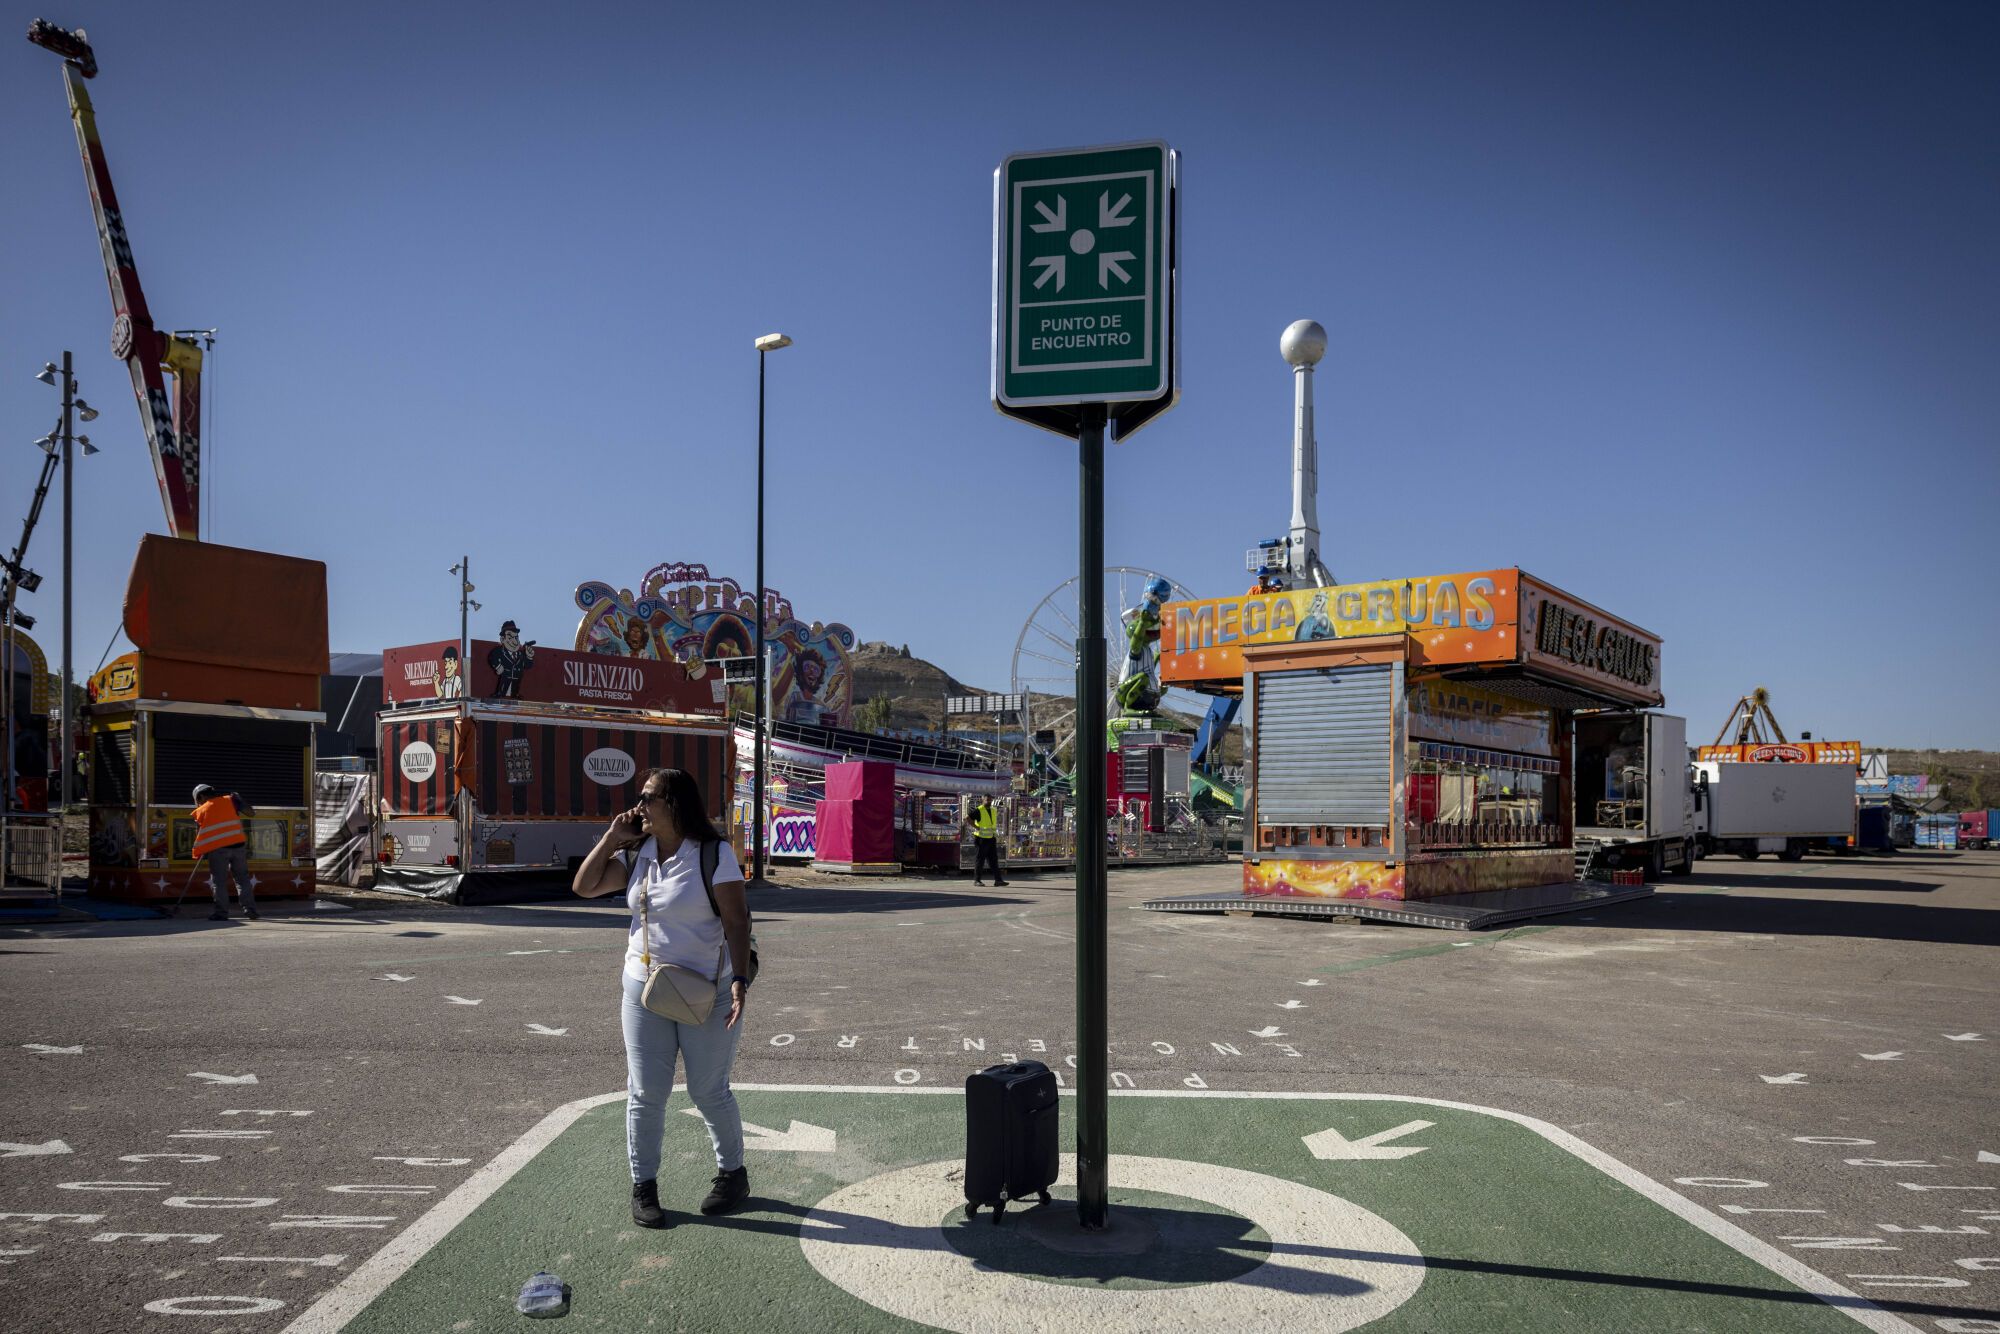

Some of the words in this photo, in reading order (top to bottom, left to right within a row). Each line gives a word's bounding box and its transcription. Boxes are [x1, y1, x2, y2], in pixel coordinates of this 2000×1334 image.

[1041, 316, 1096, 332] PUNTO
[1100, 315, 1122, 329] DE
[1031, 332, 1131, 350] ENCUENTRO
[1175, 598, 1295, 656] MEGA
[1335, 577, 1496, 632] GRUAS
[404, 660, 438, 680] SILENZZIO
[563, 660, 644, 692] SILENZZIO
[579, 688, 602, 698] PASTA
[603, 691, 633, 701] FRESCA
[403, 752, 433, 768] SILENZZIO
[588, 757, 630, 772] SILENZZIO
